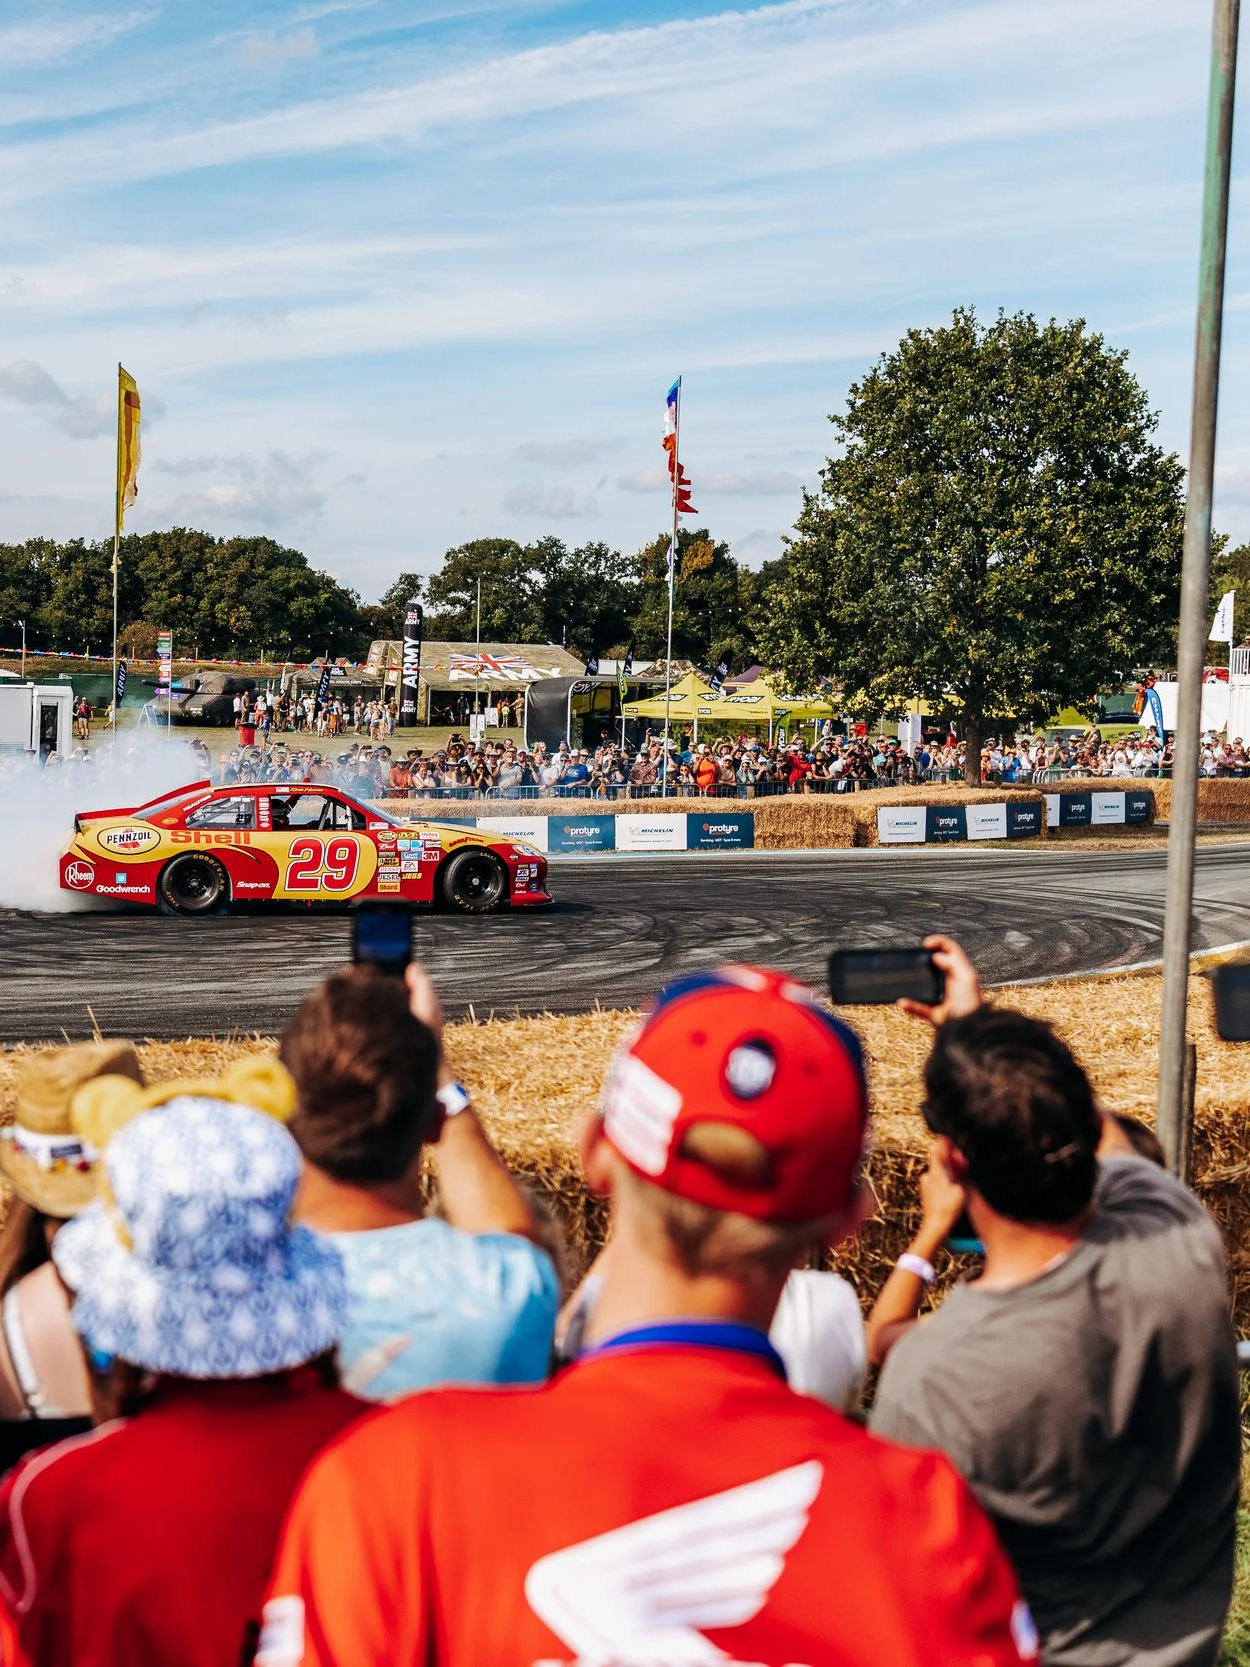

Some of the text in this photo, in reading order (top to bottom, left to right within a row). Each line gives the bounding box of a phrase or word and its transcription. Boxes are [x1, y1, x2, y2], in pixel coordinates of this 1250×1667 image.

[403, 636, 419, 689] ARMY
[116, 664, 127, 697] ARMY
[449, 667, 562, 681] ARMY
[939, 817, 958, 827] protyre
[1017, 813, 1034, 823] protyre
[570, 826, 600, 837] protyre
[709, 824, 739, 835] protyre
[106, 831, 152, 844] PENNZOIL
[170, 830, 250, 844] Shell
[423, 852, 438, 860] 3M
[284, 836, 361, 892] 29
[68, 862, 93, 884] Rheem
[96, 884, 150, 893] Goodwrench
